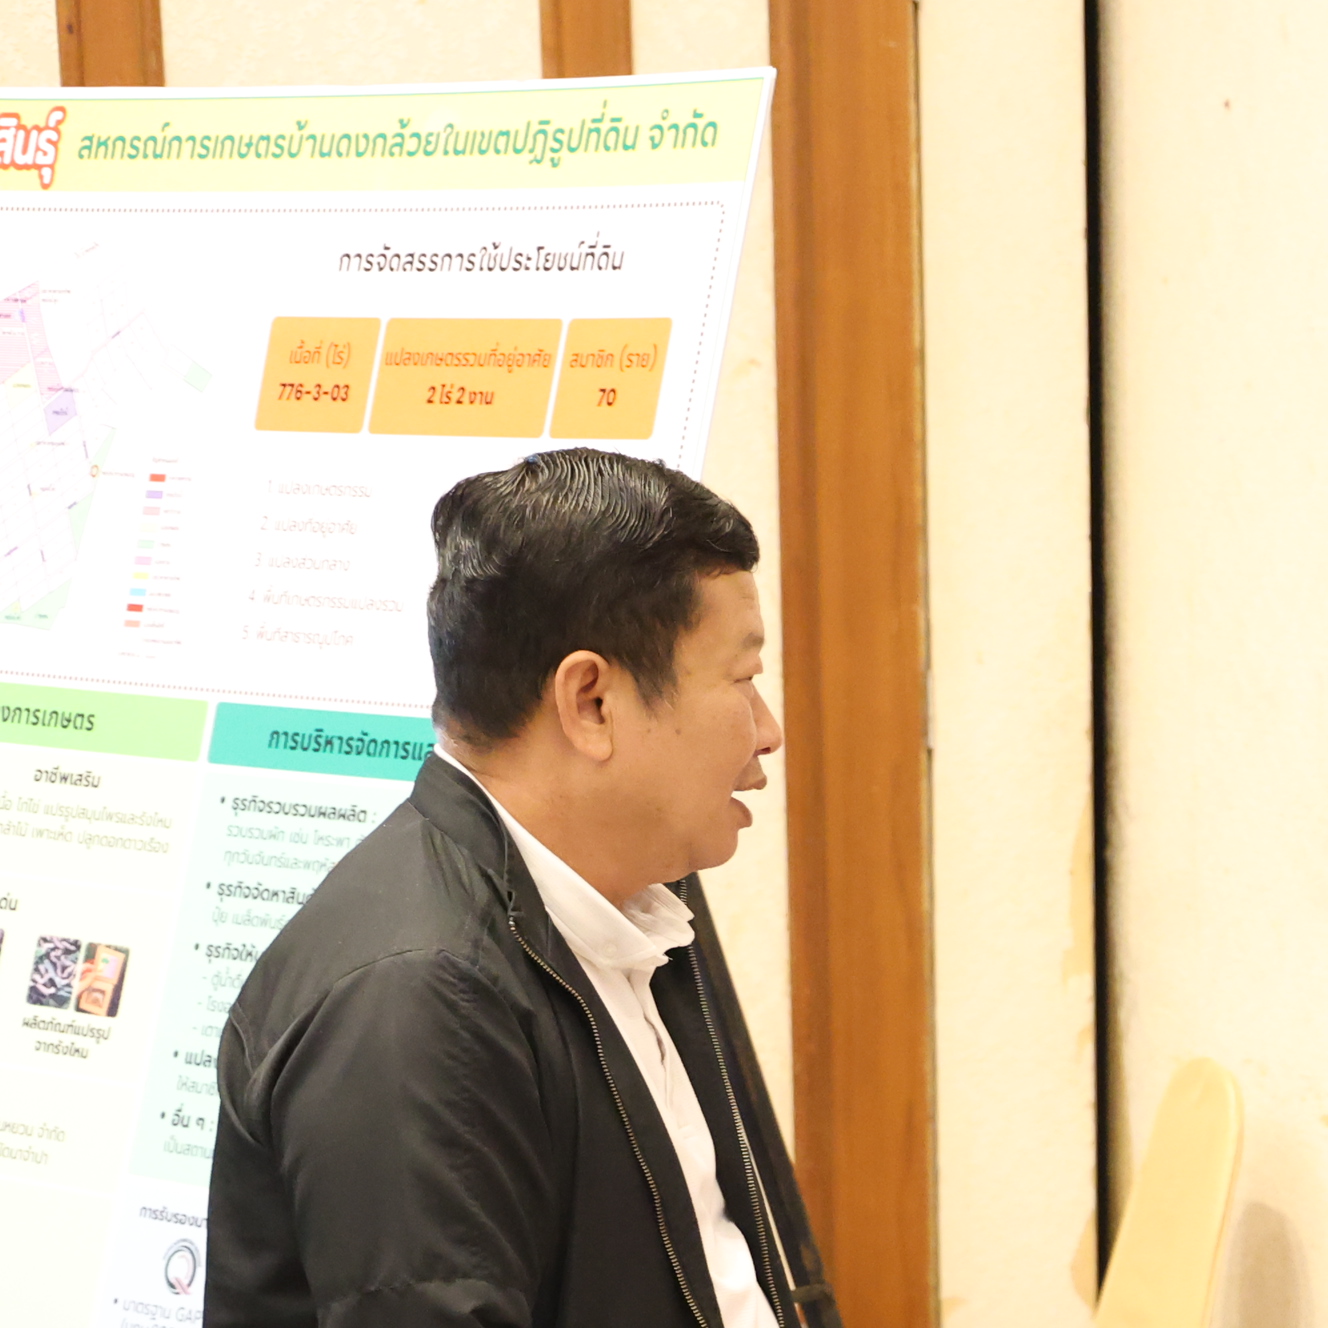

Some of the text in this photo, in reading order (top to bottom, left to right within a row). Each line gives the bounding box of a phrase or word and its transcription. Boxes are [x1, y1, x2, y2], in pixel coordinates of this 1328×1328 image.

[78, 99, 719, 169] สหกรณ์การเกษตรบ้านดงกล้วยในเขตปฏิรูปที่ดิน จำกัด
[338, 230, 625, 273] การจัดสรรการใช้ประโยชน์ที่ดิน
[289, 340, 352, 370] เนื้อที่ (ไร่)
[569, 343, 658, 373] สมาชิก (ราย)
[277, 382, 350, 402] 776-3-03
[426, 383, 495, 406] 2 ไร่ 2 งาน
[596, 388, 617, 407] 70
[33, 765, 102, 789] อาชีพเสริม
[231, 795, 367, 824] ธุรกิจรวบรวมผลผลิต
